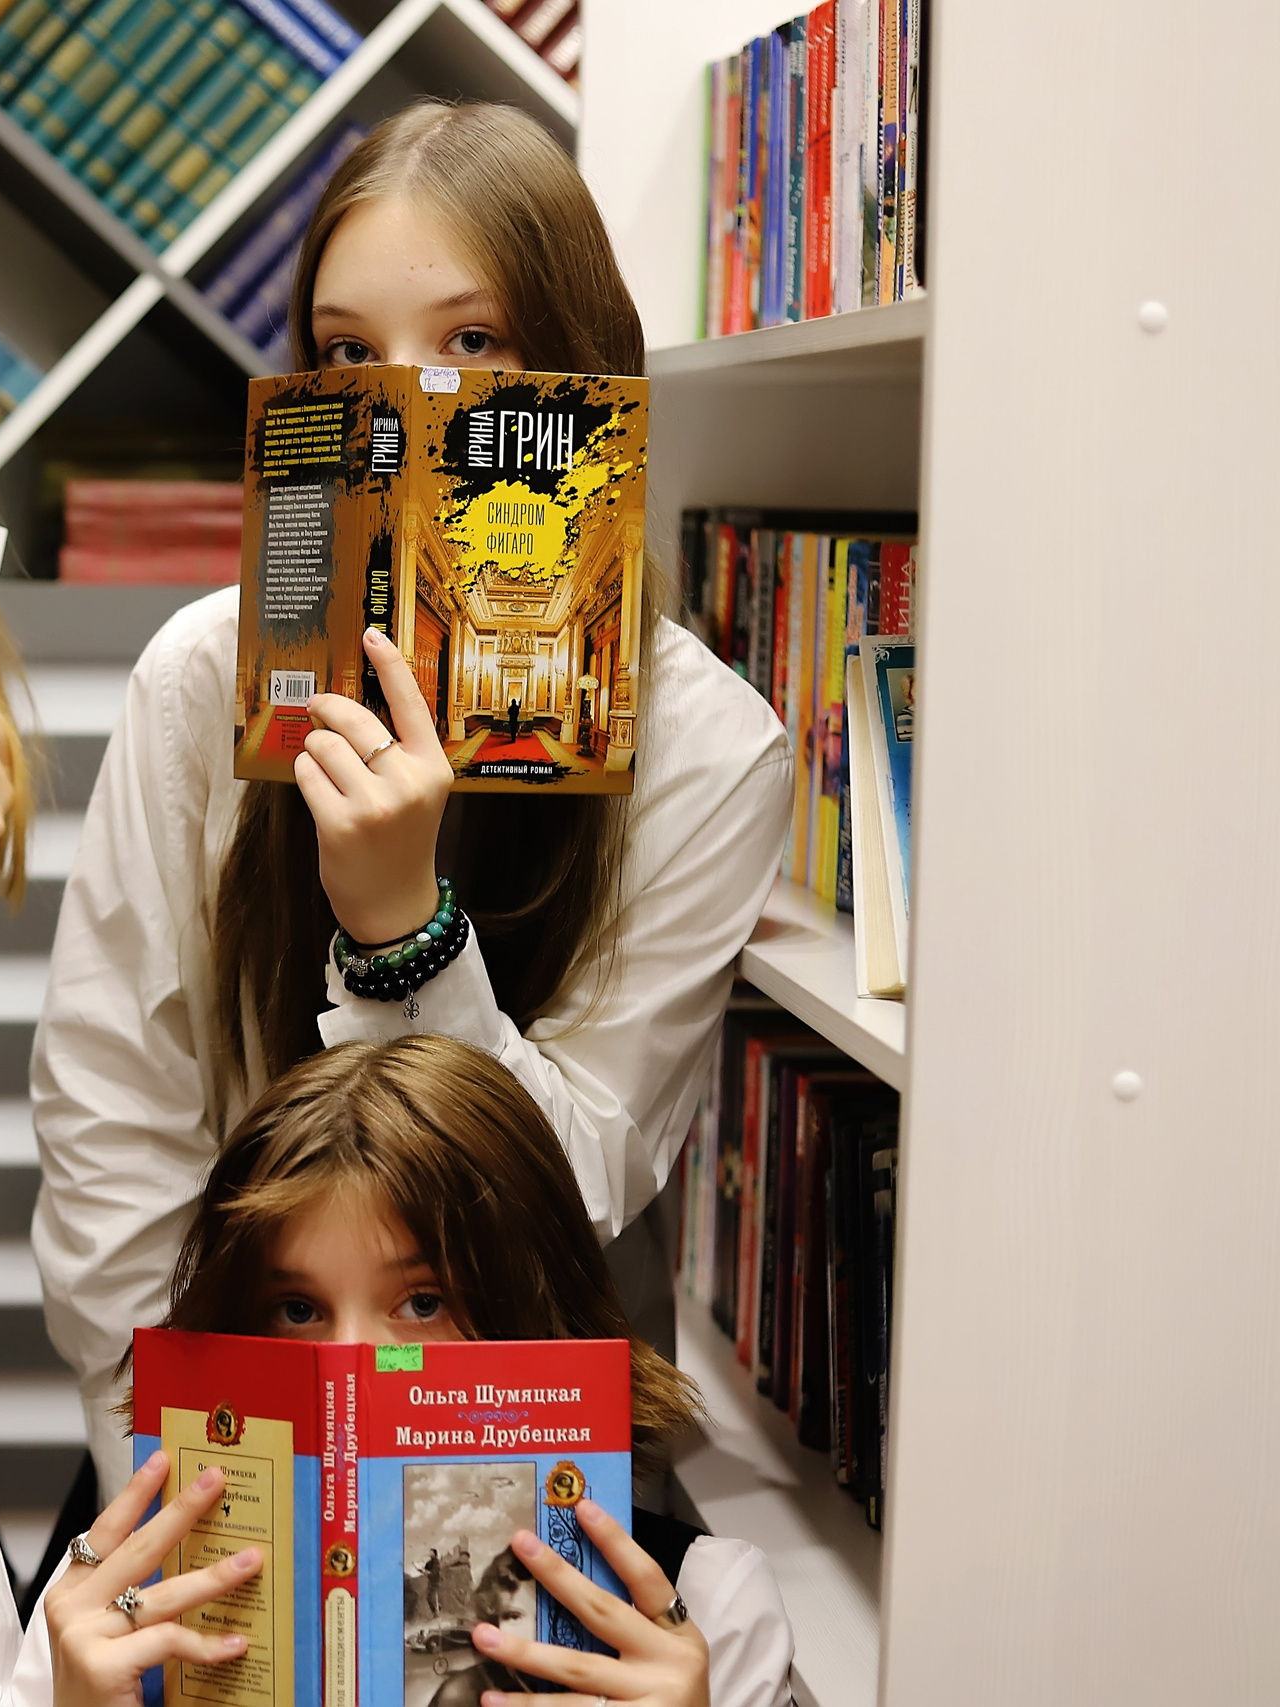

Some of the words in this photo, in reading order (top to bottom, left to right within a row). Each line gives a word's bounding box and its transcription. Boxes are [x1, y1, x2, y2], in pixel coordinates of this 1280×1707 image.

[905, 189, 918, 291] Вильмонт
[373, 418, 399, 432] ИРИНА
[468, 410, 494, 468] ИРИНА
[498, 410, 574, 471] ГРИН
[371, 433, 399, 473] ГРИН
[487, 501, 545, 527] СИНДРОМ
[486, 533, 535, 556] ФИГАРО
[370, 569, 390, 615] ФИГАРО
[480, 765, 528, 775] ДЕТЕКТИВНЫЙ
[530, 766, 553, 775] РОМАН
[344, 1373, 358, 1463] Друбецкая
[409, 1386, 469, 1406] Ольга
[475, 1385, 581, 1408] Шумяцкая
[323, 1381, 337, 1468] Шумяцкая
[396, 1426, 475, 1449] Марина
[481, 1425, 591, 1448] Друбецкая
[324, 1473, 335, 1522] Ольга
[344, 1468, 358, 1533] Марина
[203, 1545, 219, 1555] Ольга
[201, 1612, 222, 1624] Марина
[337, 1596, 345, 1686] аплодисменты
